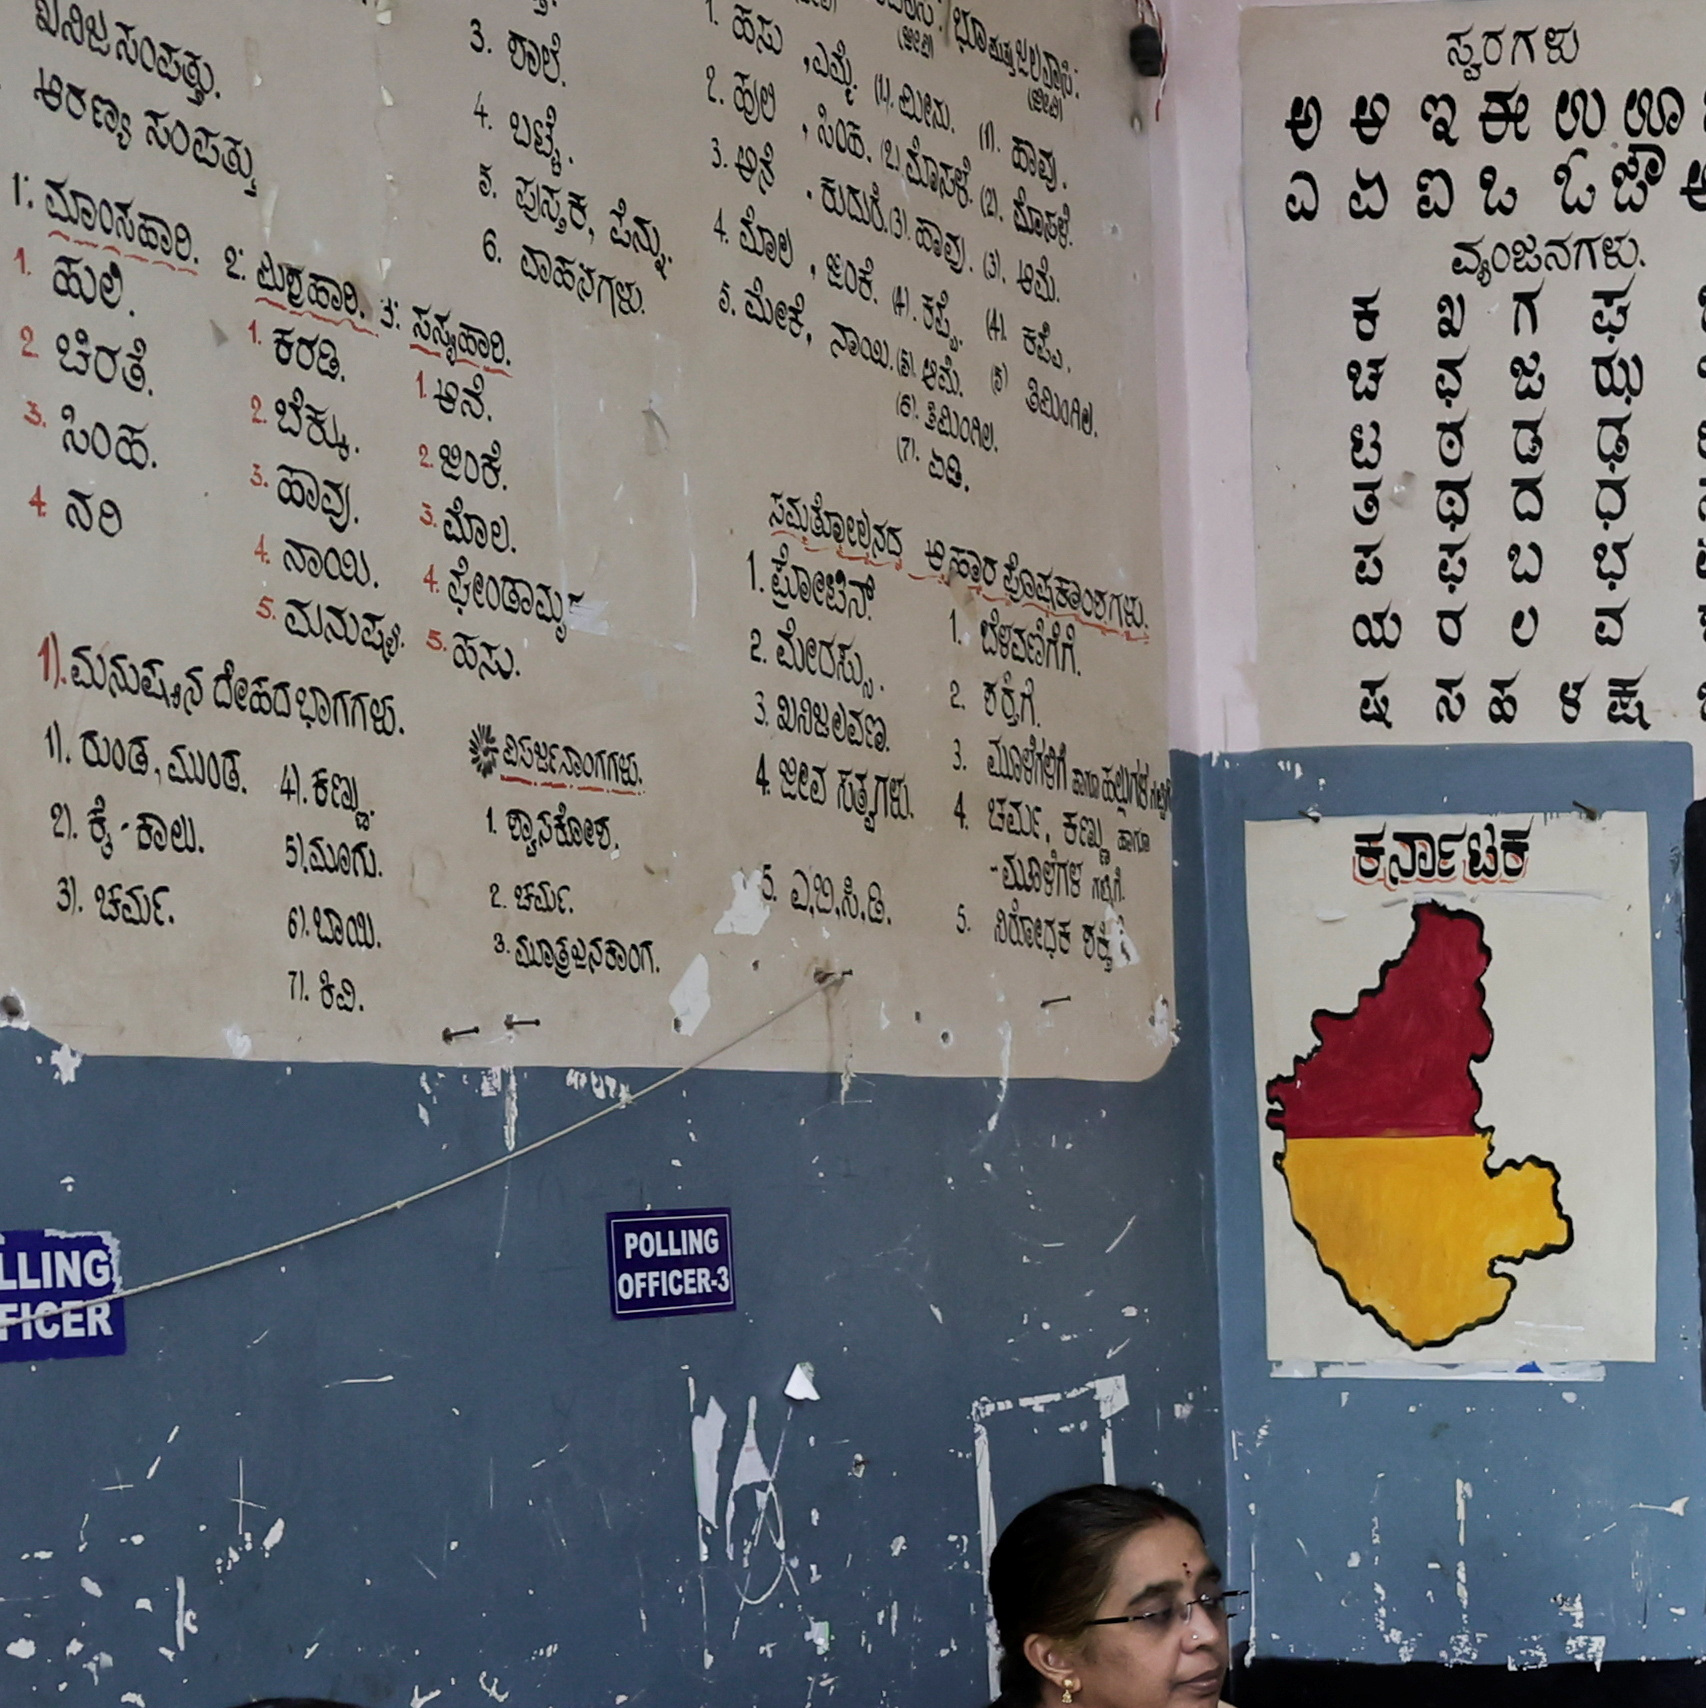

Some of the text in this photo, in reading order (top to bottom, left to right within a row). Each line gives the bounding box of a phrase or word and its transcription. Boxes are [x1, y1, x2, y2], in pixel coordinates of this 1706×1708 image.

[1446, 21, 1580, 82] ಸ್ವರಗಳು
[1420, 93, 1460, 148] ಇ
[1555, 87, 1607, 142] ಉ
[1353, 816, 1534, 891] ಕರ್ನಾಟಕ
[625, 1228, 720, 1259] POLLING
[617, 1265, 730, 1301] OFFICER-3
